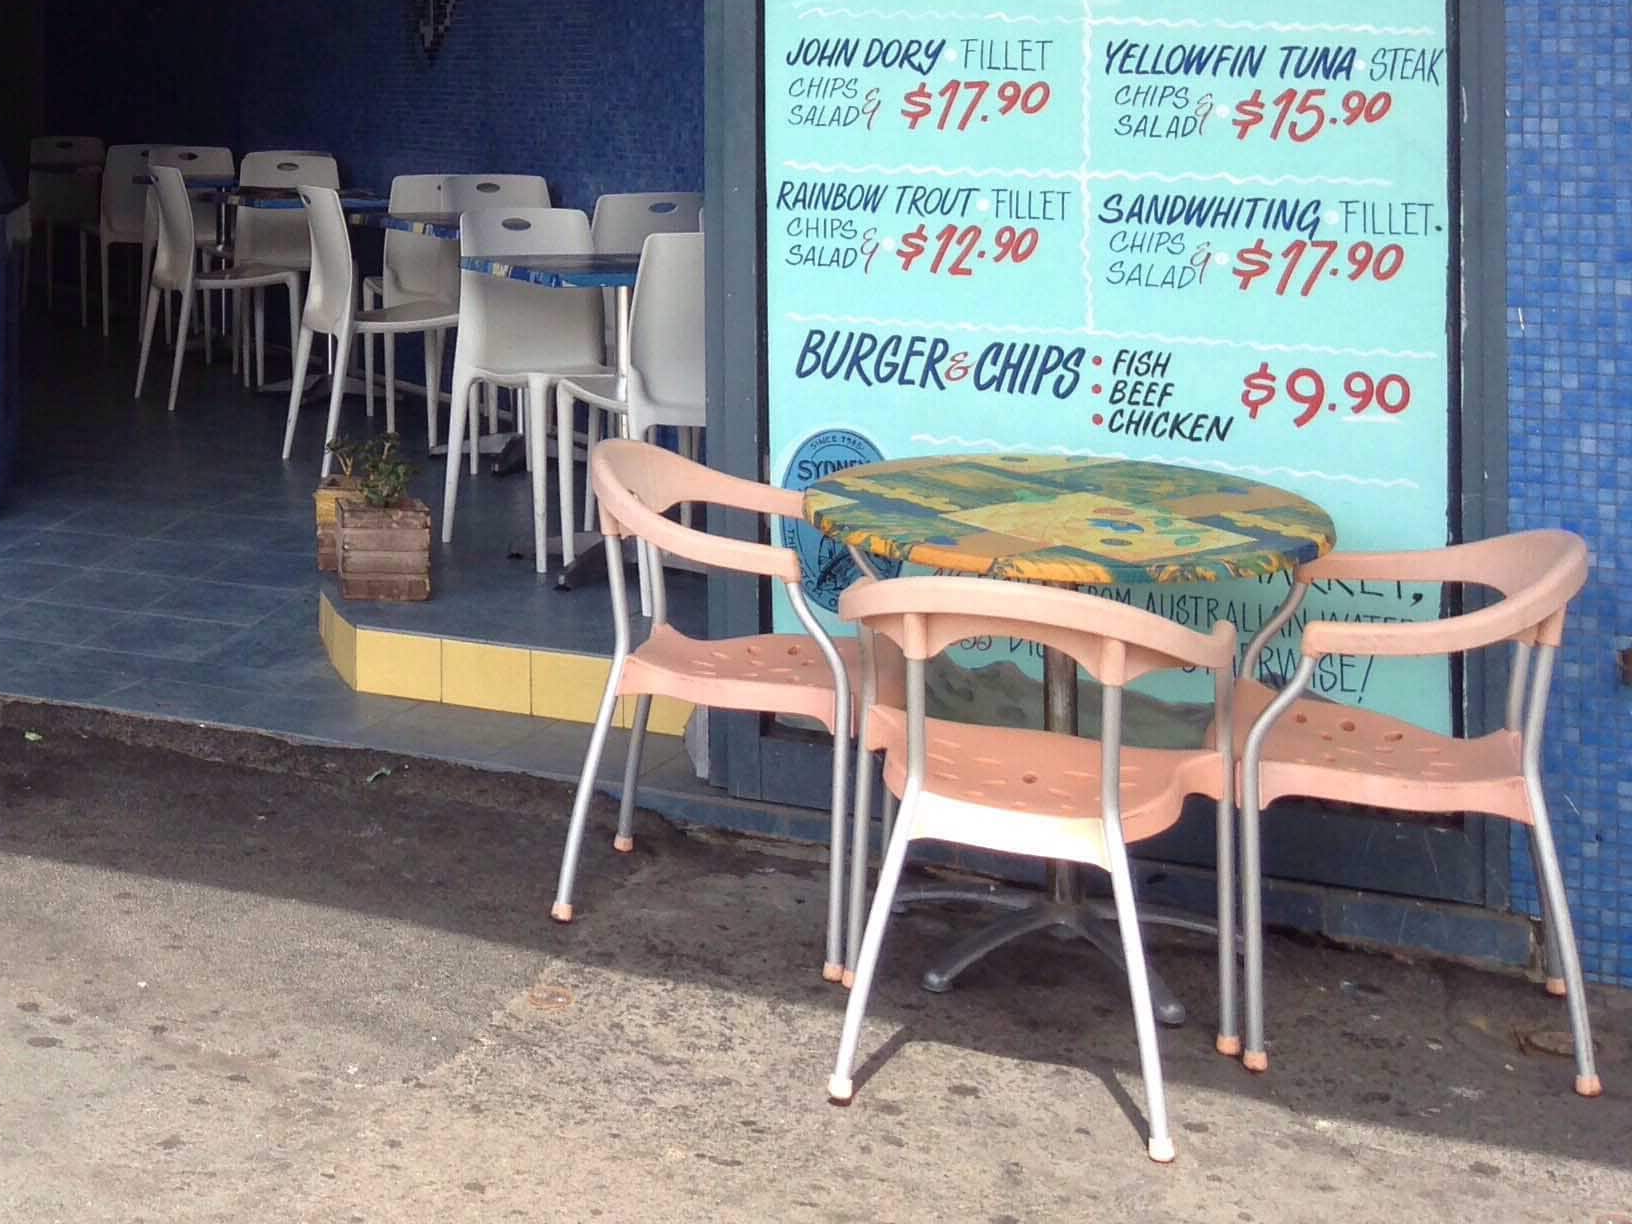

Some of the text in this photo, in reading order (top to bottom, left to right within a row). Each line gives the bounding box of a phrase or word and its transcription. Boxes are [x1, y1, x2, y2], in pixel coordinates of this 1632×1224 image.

[786, 38, 1054, 76] JOHN DORY FILLET
[1105, 38, 1445, 87] YELLOWFIN TUNA STEAK
[788, 77, 859, 100] CHIPS
[1114, 84, 1190, 110] CHIPS
[788, 104, 861, 128] SALAD
[900, 79, 1051, 132] $17.90
[1231, 88, 1393, 143] $15.90
[1114, 114, 1197, 139] SALAD
[776, 180, 1072, 221] RAINBOW TROUT FILLET
[786, 216, 858, 240] CHIPS
[1098, 193, 1322, 240] SANDWHITING
[785, 244, 858, 269] SALAD
[895, 223, 1041, 277] $12.90
[1109, 230, 1186, 255] CHIPS
[1106, 261, 1196, 289] SALAD
[1231, 238, 1406, 296] $17.90
[796, 329, 948, 392] BURGER
[974, 341, 1086, 400] CHIPS
[1112, 349, 1171, 378] FISH
[1108, 380, 1176, 408] BEEF
[1240, 362, 1411, 429] $9.90
[1108, 410, 1234, 443] CHICKEN
[798, 459, 871, 481] SYDN
